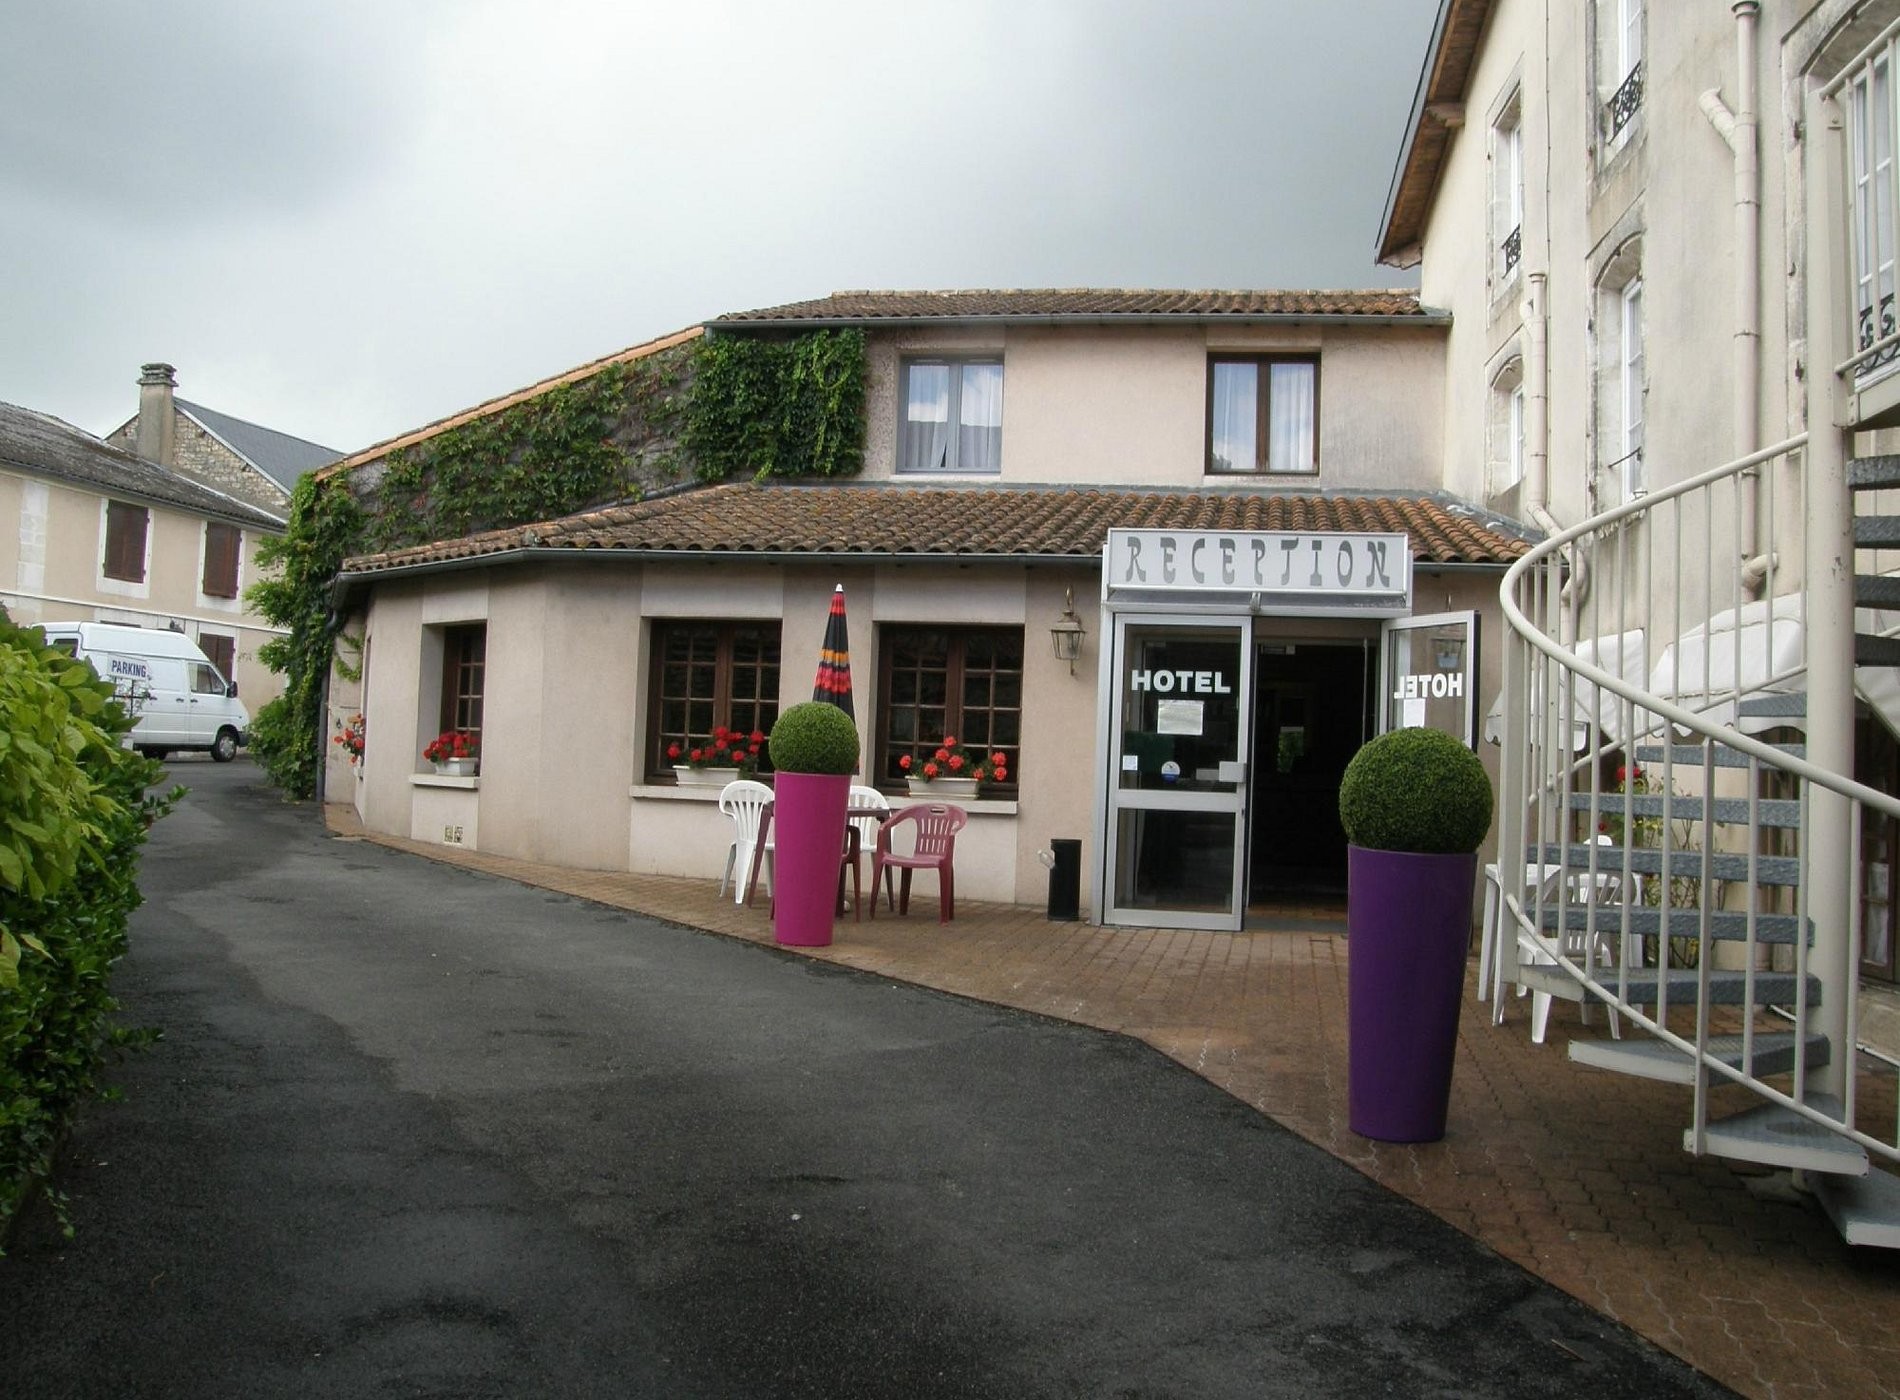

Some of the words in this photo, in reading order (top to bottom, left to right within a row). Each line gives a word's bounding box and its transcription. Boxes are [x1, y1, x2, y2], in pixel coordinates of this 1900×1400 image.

[1126, 536, 1390, 587] RECEPTION
[112, 660, 146, 677] PARKING
[1131, 669, 1231, 693] HOTEL
